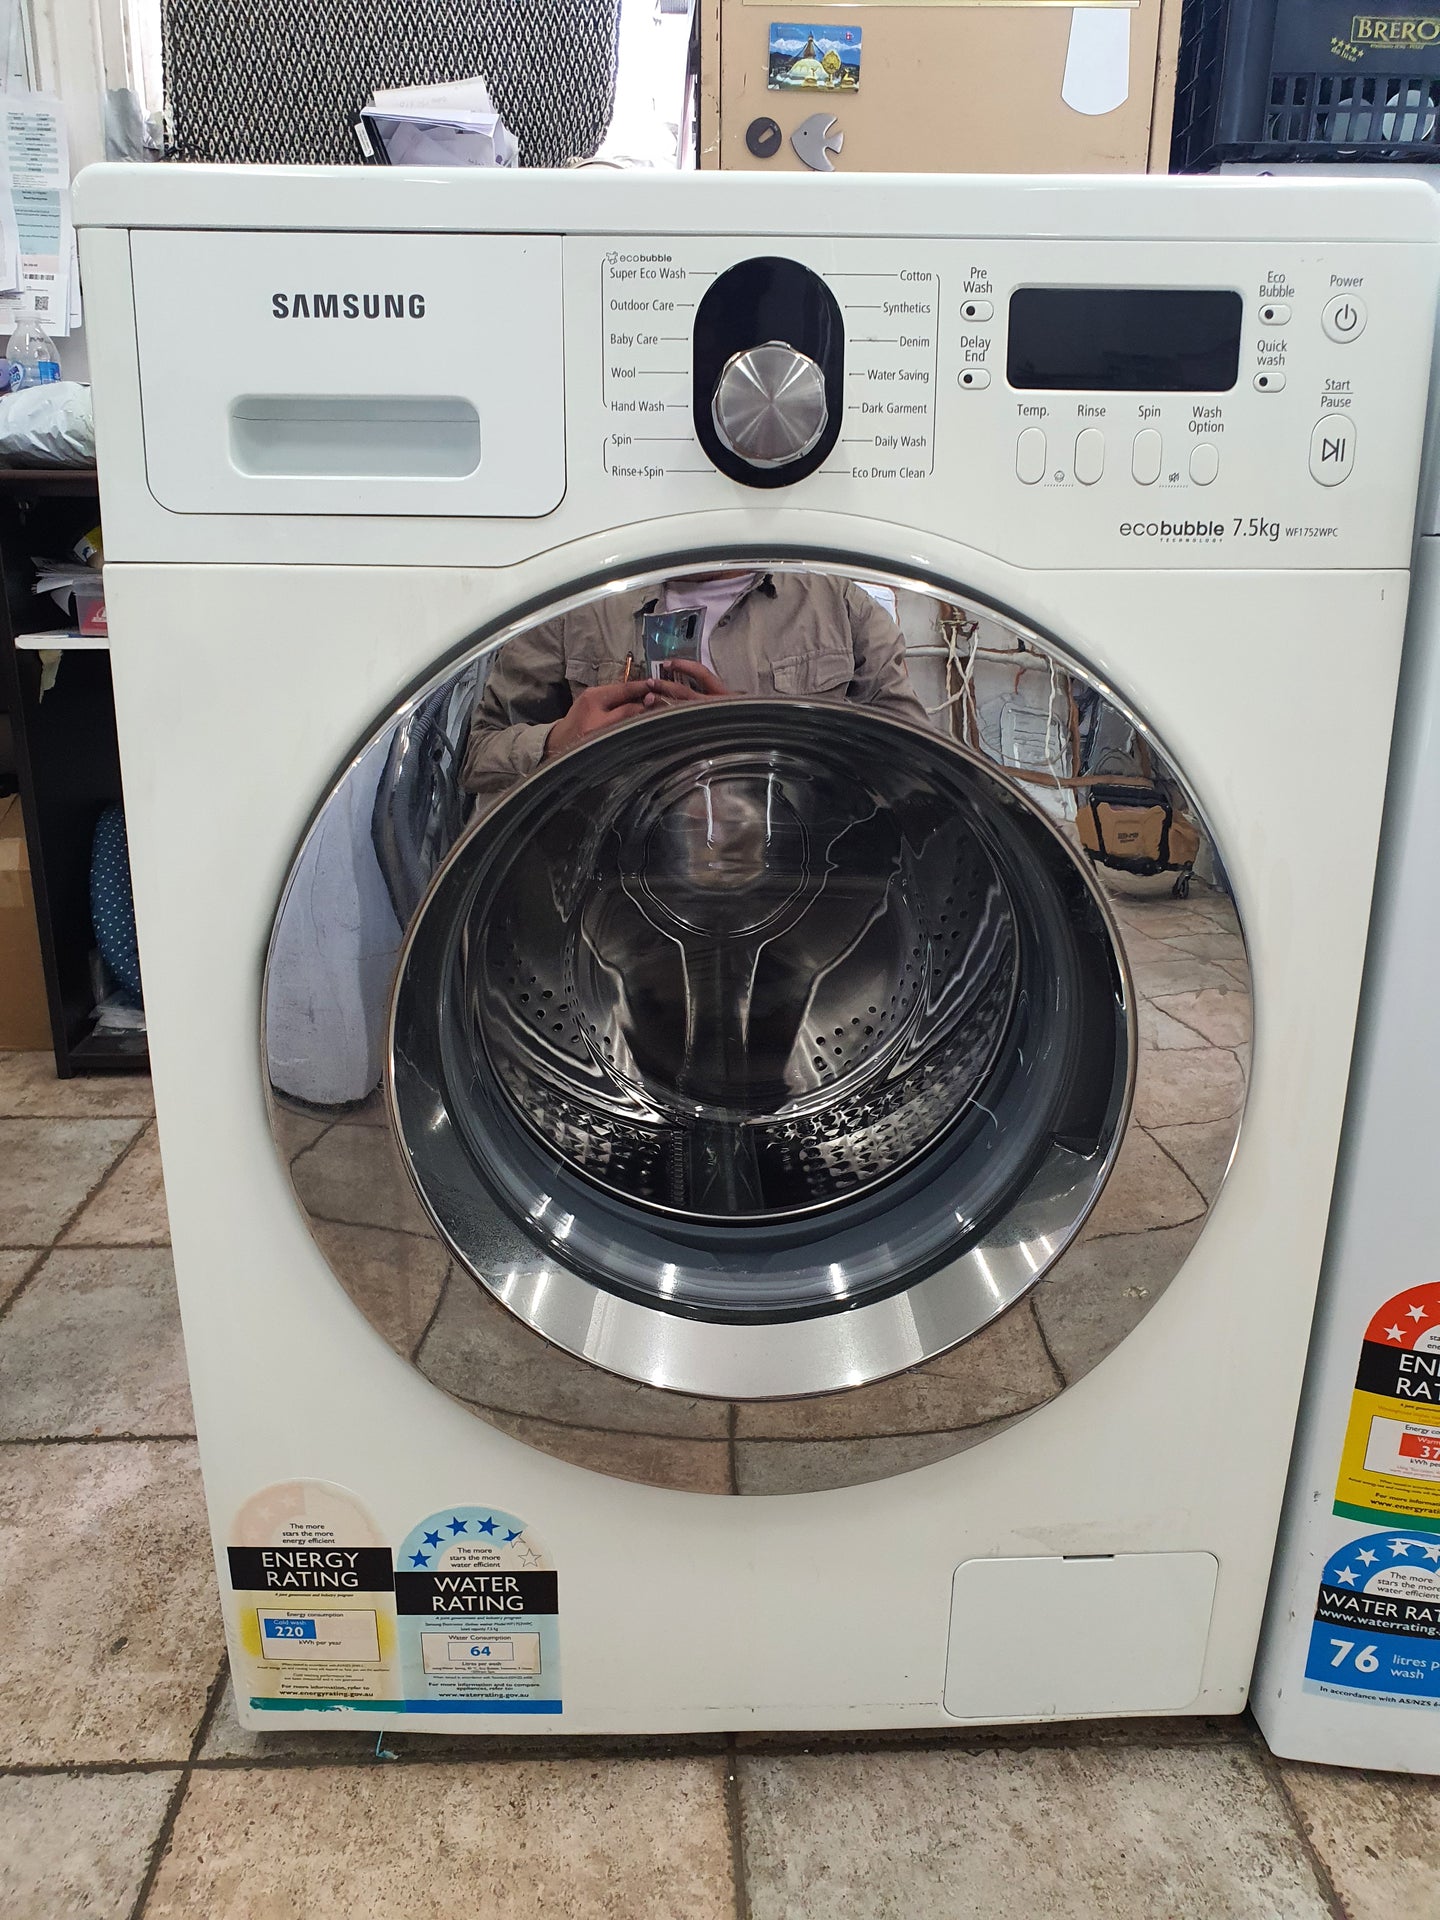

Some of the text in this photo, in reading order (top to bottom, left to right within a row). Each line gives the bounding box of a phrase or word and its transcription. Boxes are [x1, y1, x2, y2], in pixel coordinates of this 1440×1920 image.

[619, 253, 672, 263] ecobubble
[609, 267, 686, 282] Super Eco Wash
[899, 269, 932, 282] Cotton
[970, 266, 988, 280] Pre
[1267, 270, 1286, 284] Eco
[963, 281, 993, 294] Wash
[1329, 274, 1364, 288] Power
[1259, 285, 1295, 298] Bubble
[272, 293, 426, 319] SAMSUNG
[609, 299, 675, 311] Outdoor Care
[883, 301, 931, 316] Synthetics
[609, 333, 659, 348] Baby Care
[899, 336, 930, 347] Denim
[960, 335, 992, 351] Delay
[1256, 339, 1288, 353] Quick
[965, 350, 987, 362] End
[1256, 354, 1286, 366] wash
[610, 366, 636, 378] Wool
[867, 369, 930, 384] Water Saving
[1324, 378, 1351, 391] Start
[611, 400, 665, 412] Hand Wash
[861, 402, 928, 414] Dark Garment
[1320, 395, 1352, 408] Pause
[1017, 403, 1050, 420] Temp.
[1077, 404, 1106, 417] Rinse
[1138, 405, 1161, 420] Spin
[1192, 406, 1223, 418] Wash
[1188, 420, 1225, 434] Option
[611, 433, 632, 447] Spin
[874, 435, 927, 449] Daily Wash
[611, 465, 664, 480] Rinse+Spin
[852, 467, 926, 479] Eco Drum Clean
[1119, 516, 1339, 542] ecobubble 7.5kg WF1752WPC
[1398, 1353, 1440, 1378] EN
[1404, 1424, 1430, 1434] Energy
[261, 1552, 360, 1568] ENERGY
[266, 1571, 359, 1587] RATING
[434, 1577, 520, 1592] WATER
[1390, 1571, 1433, 1584] The more
[1377, 1579, 1440, 1593] stars the more
[1377, 1586, 1440, 1600] water efficient
[432, 1595, 524, 1611] RATING
[1322, 1590, 1398, 1618] WATER
[1319, 1608, 1440, 1636] www.waterrating.
[275, 1626, 304, 1637] 220
[470, 1645, 491, 1656] 64
[1330, 1638, 1379, 1673] 76
[1392, 1653, 1427, 1668] litres
[1390, 1668, 1424, 1679] wash
[279, 1690, 374, 1698] www.energyrating.gov.au
[1330, 1687, 1377, 1700] accordance
[1378, 1695, 1397, 1703] with
